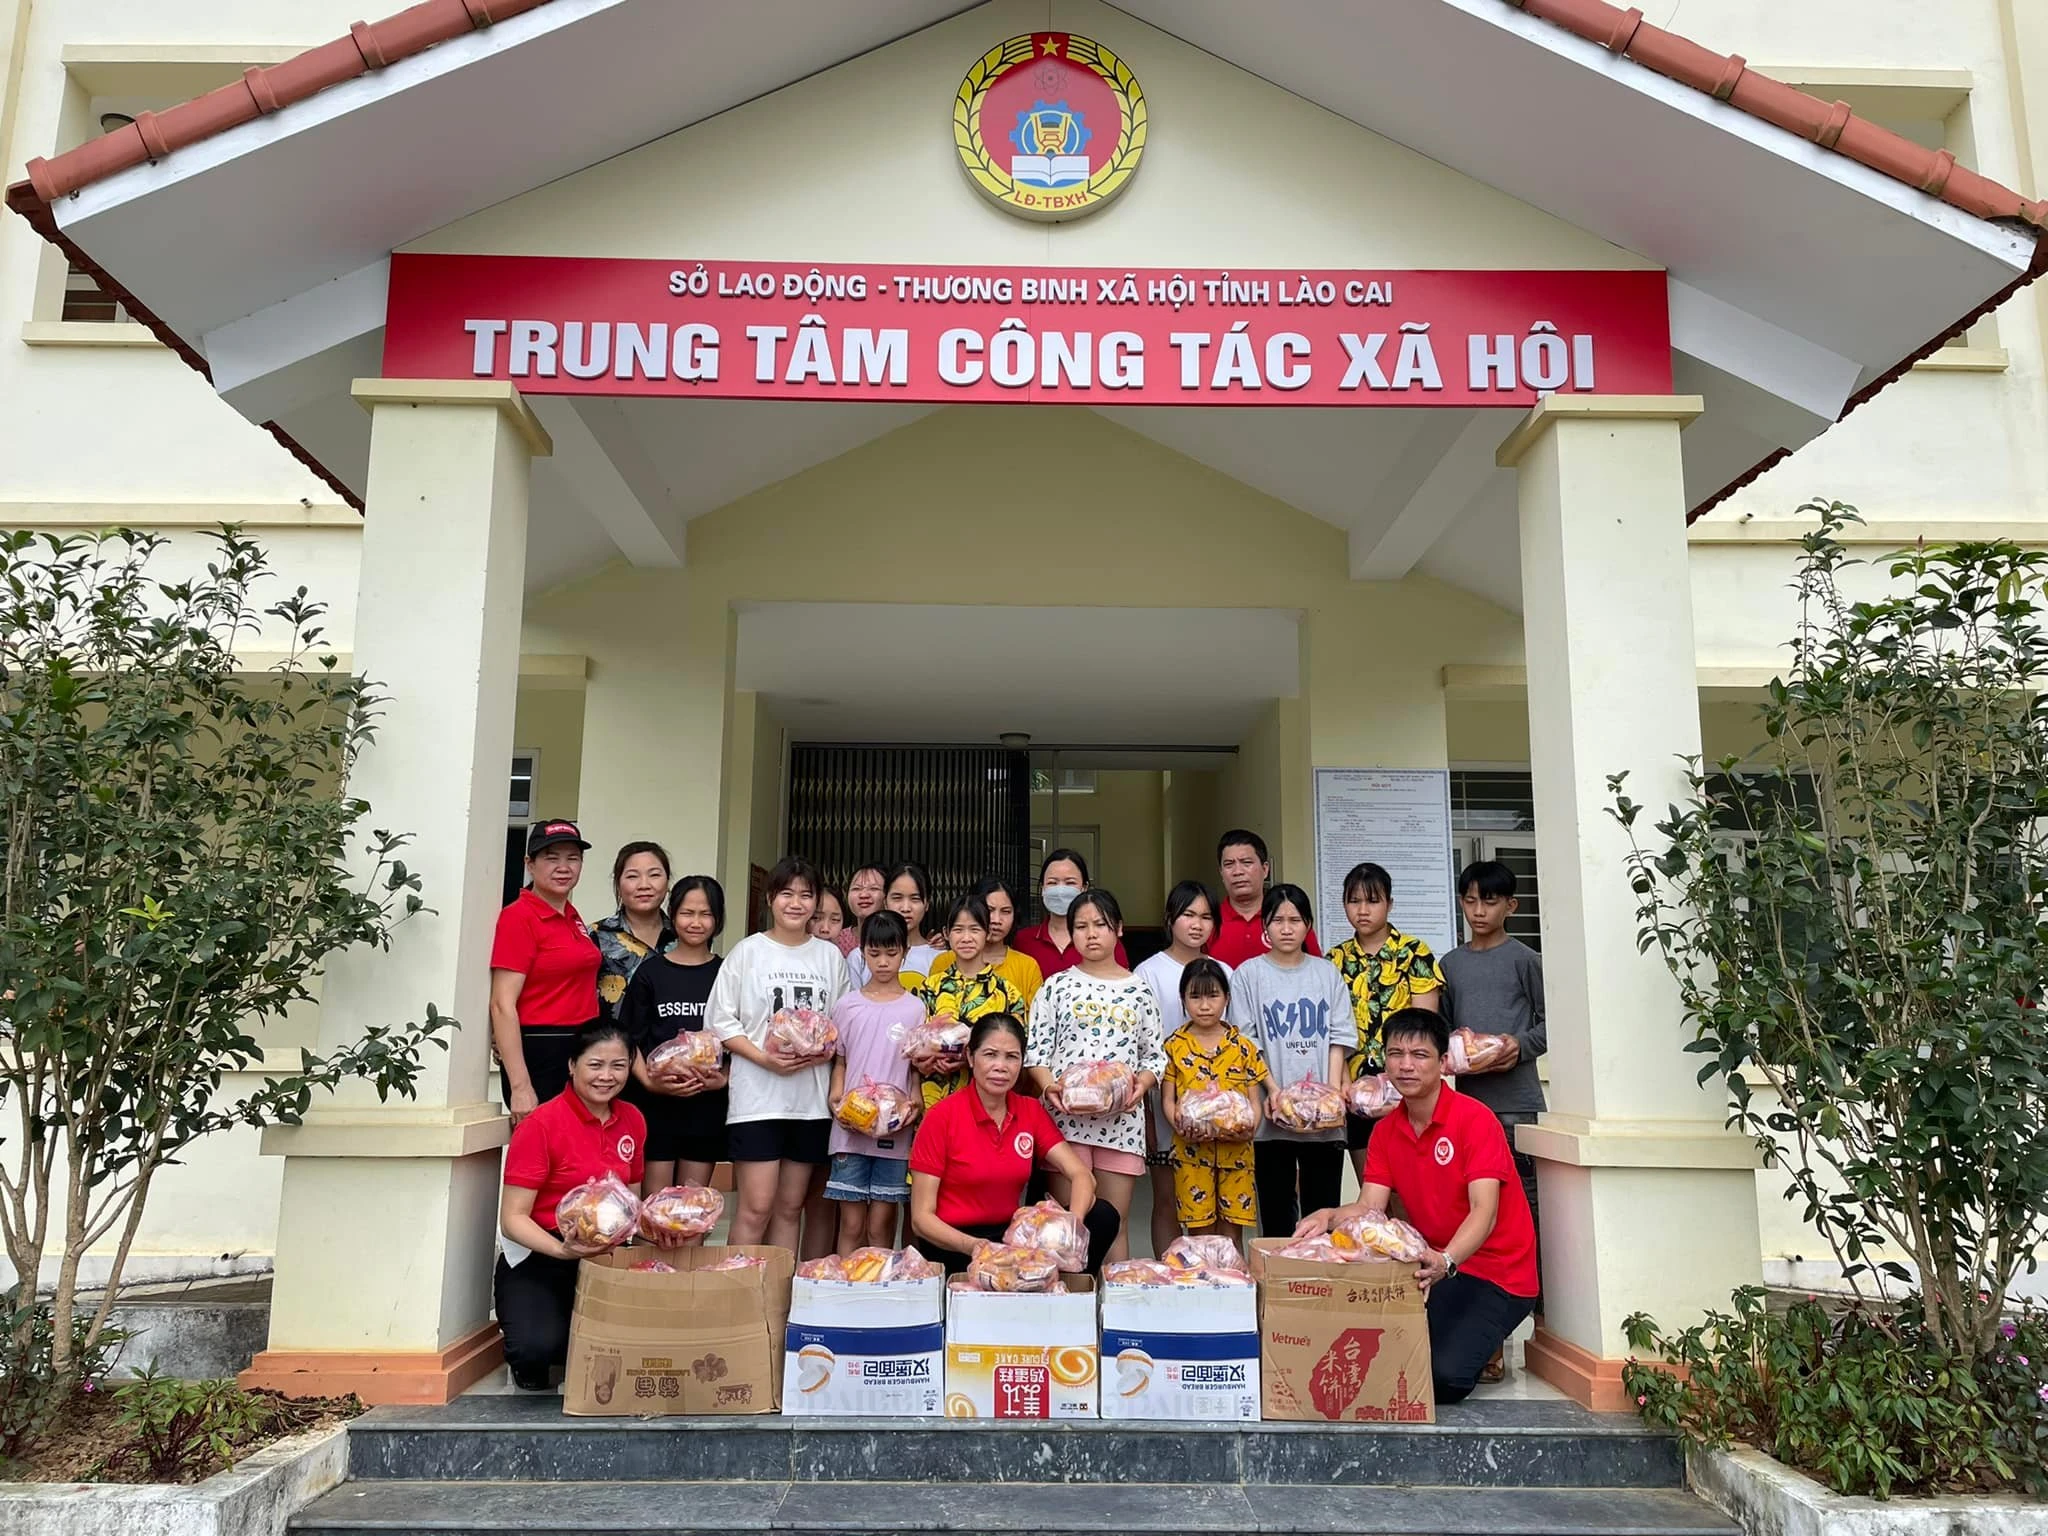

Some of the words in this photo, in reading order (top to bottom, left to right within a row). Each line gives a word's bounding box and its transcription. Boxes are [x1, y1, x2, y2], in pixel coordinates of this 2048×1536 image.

[669, 263, 709, 295] SỞ
[718, 272, 776, 297] LAO
[782, 267, 867, 303] ĐỘNG
[893, 275, 1012, 302] THƯƠNG
[1021, 278, 1088, 303] BINH
[1097, 272, 1140, 303] XÃ
[1148, 273, 1196, 310] HỘI
[1203, 271, 1270, 303] TỈNH
[1278, 275, 1336, 305] LÀO
[1345, 280, 1392, 304] CAI
[464, 319, 720, 380] TRUNG
[746, 314, 909, 384] TÂM
[938, 317, 1145, 388] CÔNG
[1170, 320, 1312, 389] TÁC
[1338, 321, 1444, 390] XÃ
[863, 1357, 930, 1377] 汉堡面包
[1181, 1364, 1246, 1382] 汉堡面包
[887, 1377, 931, 1386] HAMBURGER
